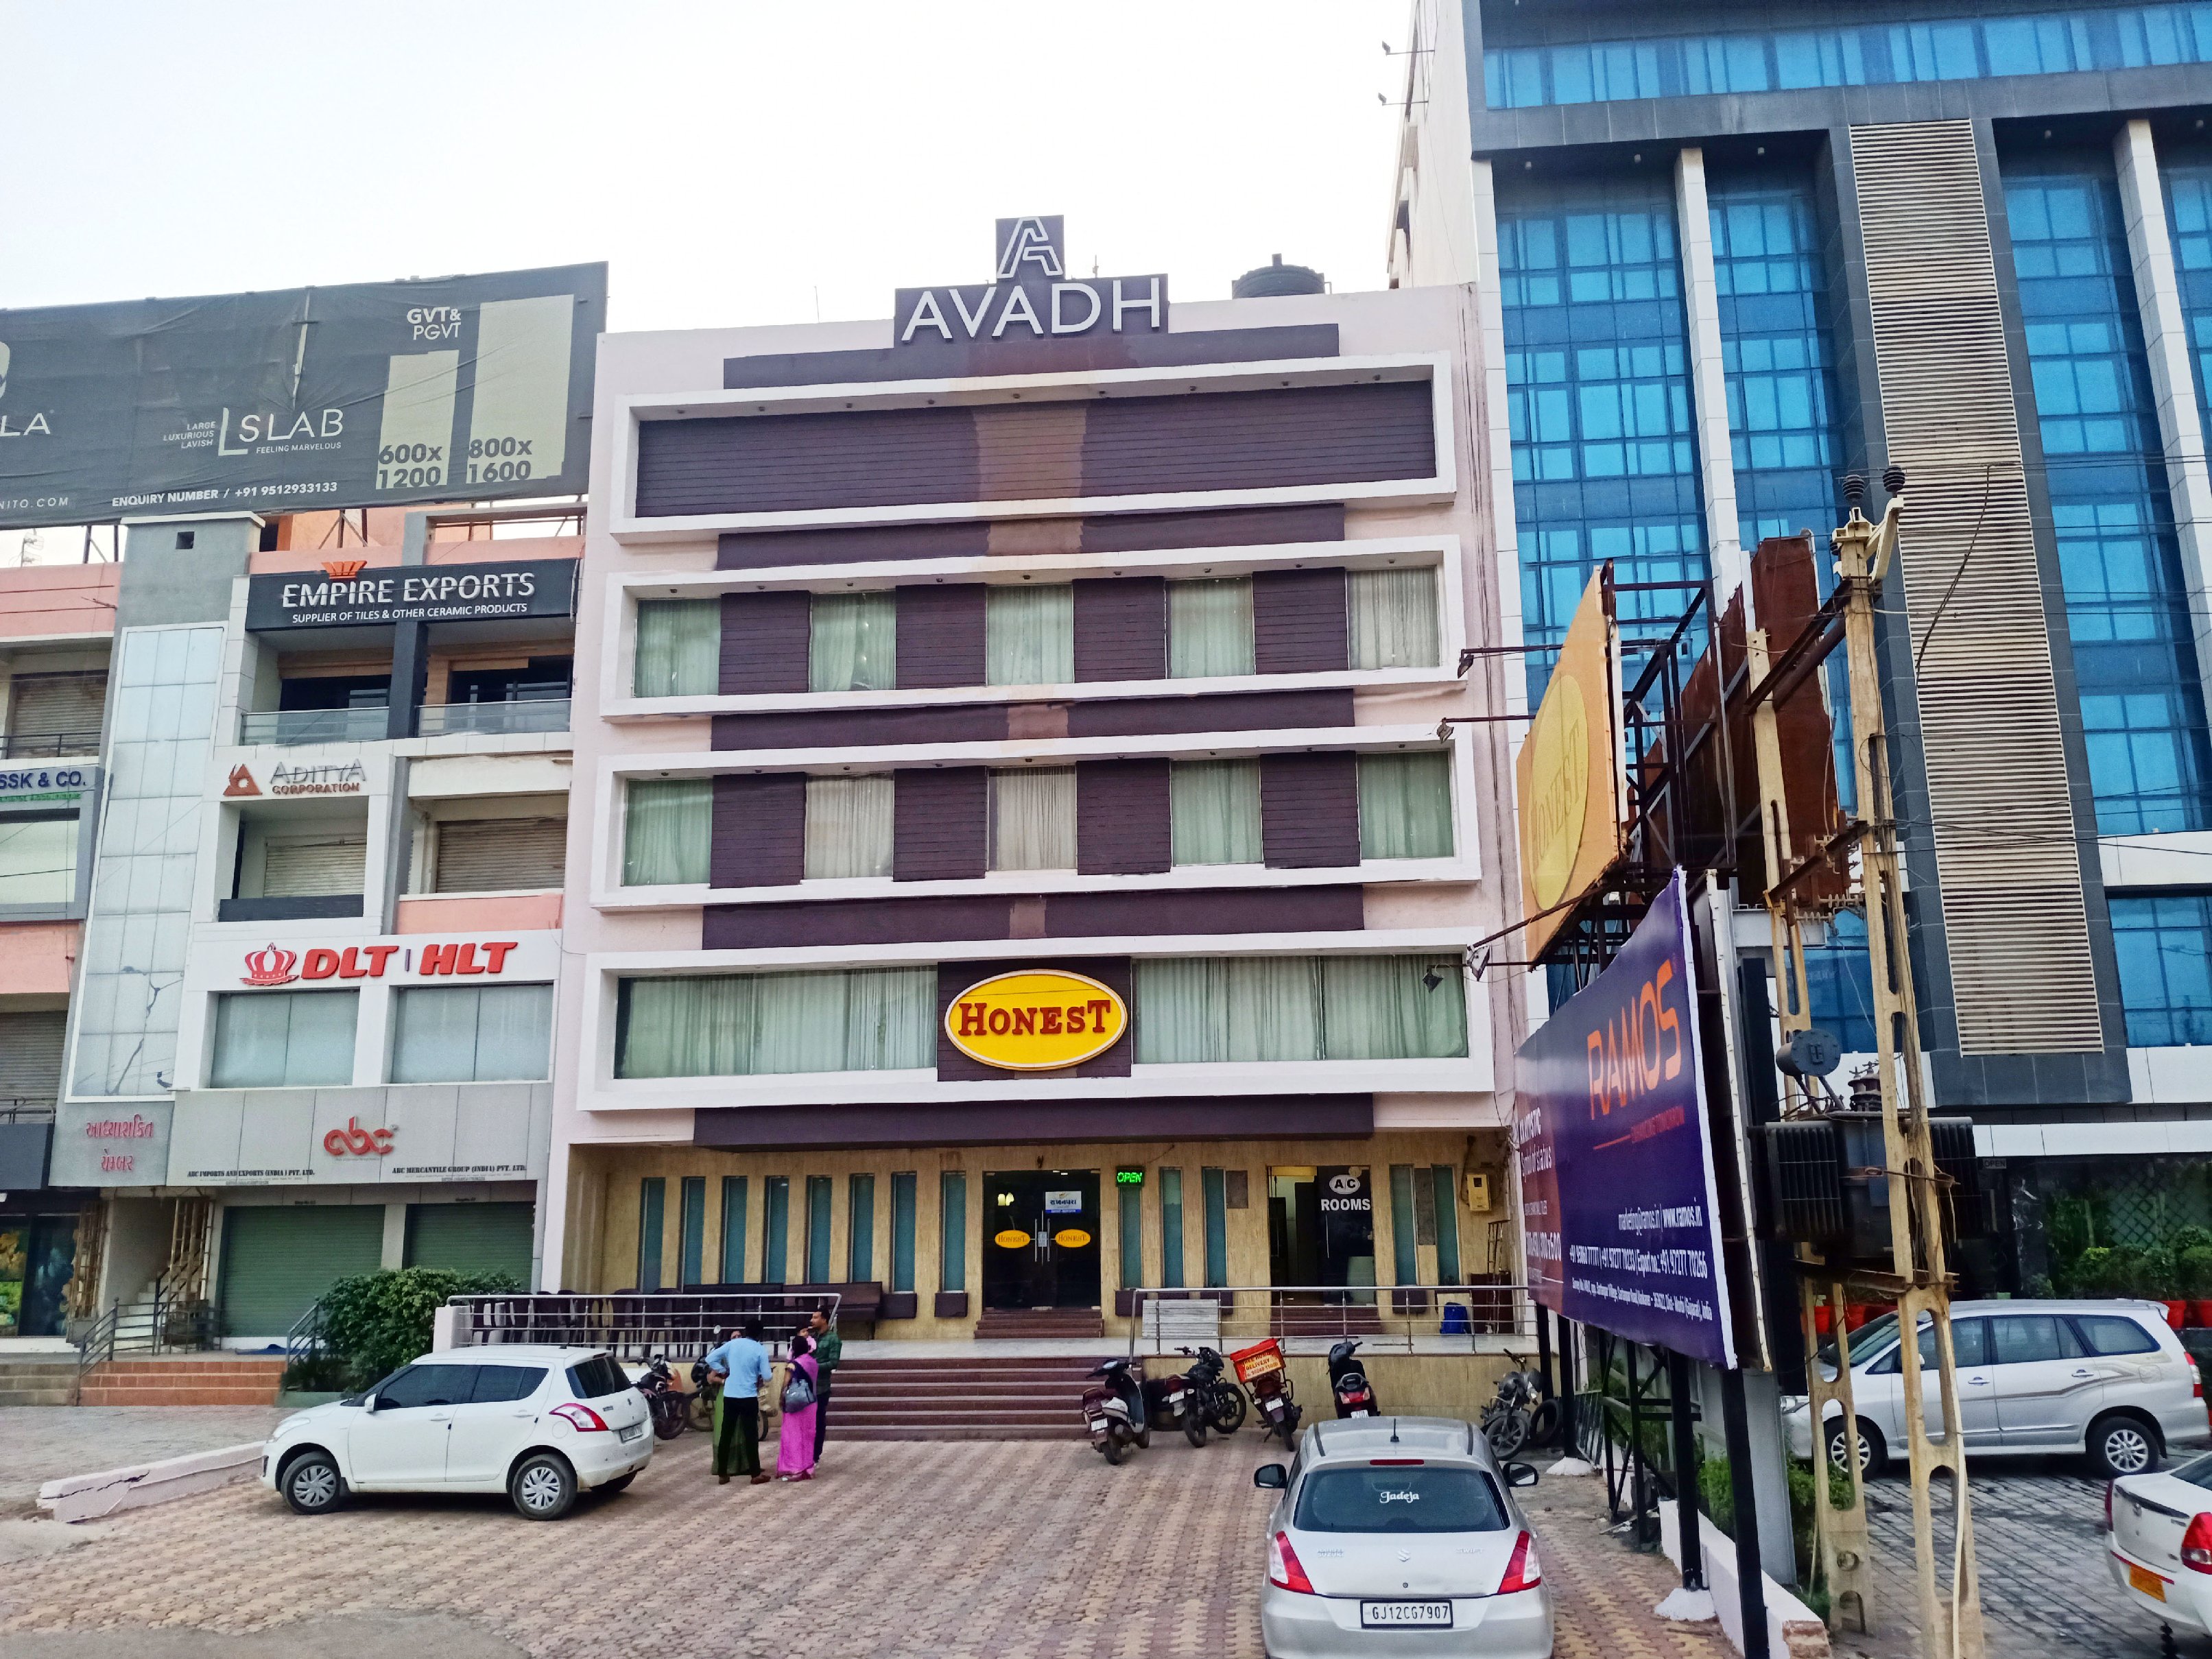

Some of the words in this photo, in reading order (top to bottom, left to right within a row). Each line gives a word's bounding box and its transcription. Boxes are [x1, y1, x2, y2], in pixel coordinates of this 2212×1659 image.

[407, 307, 462, 324] GVT&
[901, 278, 1159, 342] AVADH
[413, 322, 462, 341] PGVT
[163, 431, 215, 441] LUXURIOUS
[187, 421, 216, 431] LARGE
[181, 440, 213, 449] LAVISH
[256, 444, 289, 455] FEELING
[291, 442, 342, 452] MARVELOUS
[379, 443, 442, 465] 600x
[468, 437, 533, 459] 800x
[378, 466, 441, 489] 1200
[468, 460, 532, 483] 1600
[112, 493, 166, 508] ENQUIRY
[167, 489, 219, 503] NUMBER
[224, 488, 230, 499] /
[235, 486, 257, 497] +91
[261, 481, 338, 496] 9512933133
[282, 579, 394, 608] EMPIRE
[403, 571, 535, 602] EXPORTS
[292, 612, 337, 623] SUPPLIER
[340, 611, 353, 621] OF
[355, 610, 380, 620] TILES
[382, 609, 390, 619] &
[392, 608, 425, 619] OTHER
[427, 606, 473, 617] CERAMIC
[474, 603, 527, 614] PRODUCTS
[38, 772, 50, 788] &
[56, 771, 86, 787] CO.
[269, 759, 366, 784] ADITYA
[272, 782, 360, 795] CORPORATION
[300, 945, 399, 979] DLT
[419, 942, 519, 975] HLT
[958, 999, 1111, 1036] HONEST
[1587, 958, 1681, 1121] RAMOS
[1117, 1172, 1143, 1183] OPEN
[1320, 1198, 1371, 1211] ROOMS
[1663, 1197, 1702, 1228] www.ramos.in
[1637, 1249, 1651, 1278] Export
[1661, 1250, 1670, 1274] +91
[1669, 1250, 1687, 1276] 97277
[1687, 1250, 1708, 1279] 70266
[1246, 1358, 1270, 1370] DELIVERY
[1379, 1491, 1420, 1503] Jadeja
[1372, 1606, 1449, 1620] GJ12CG7907
